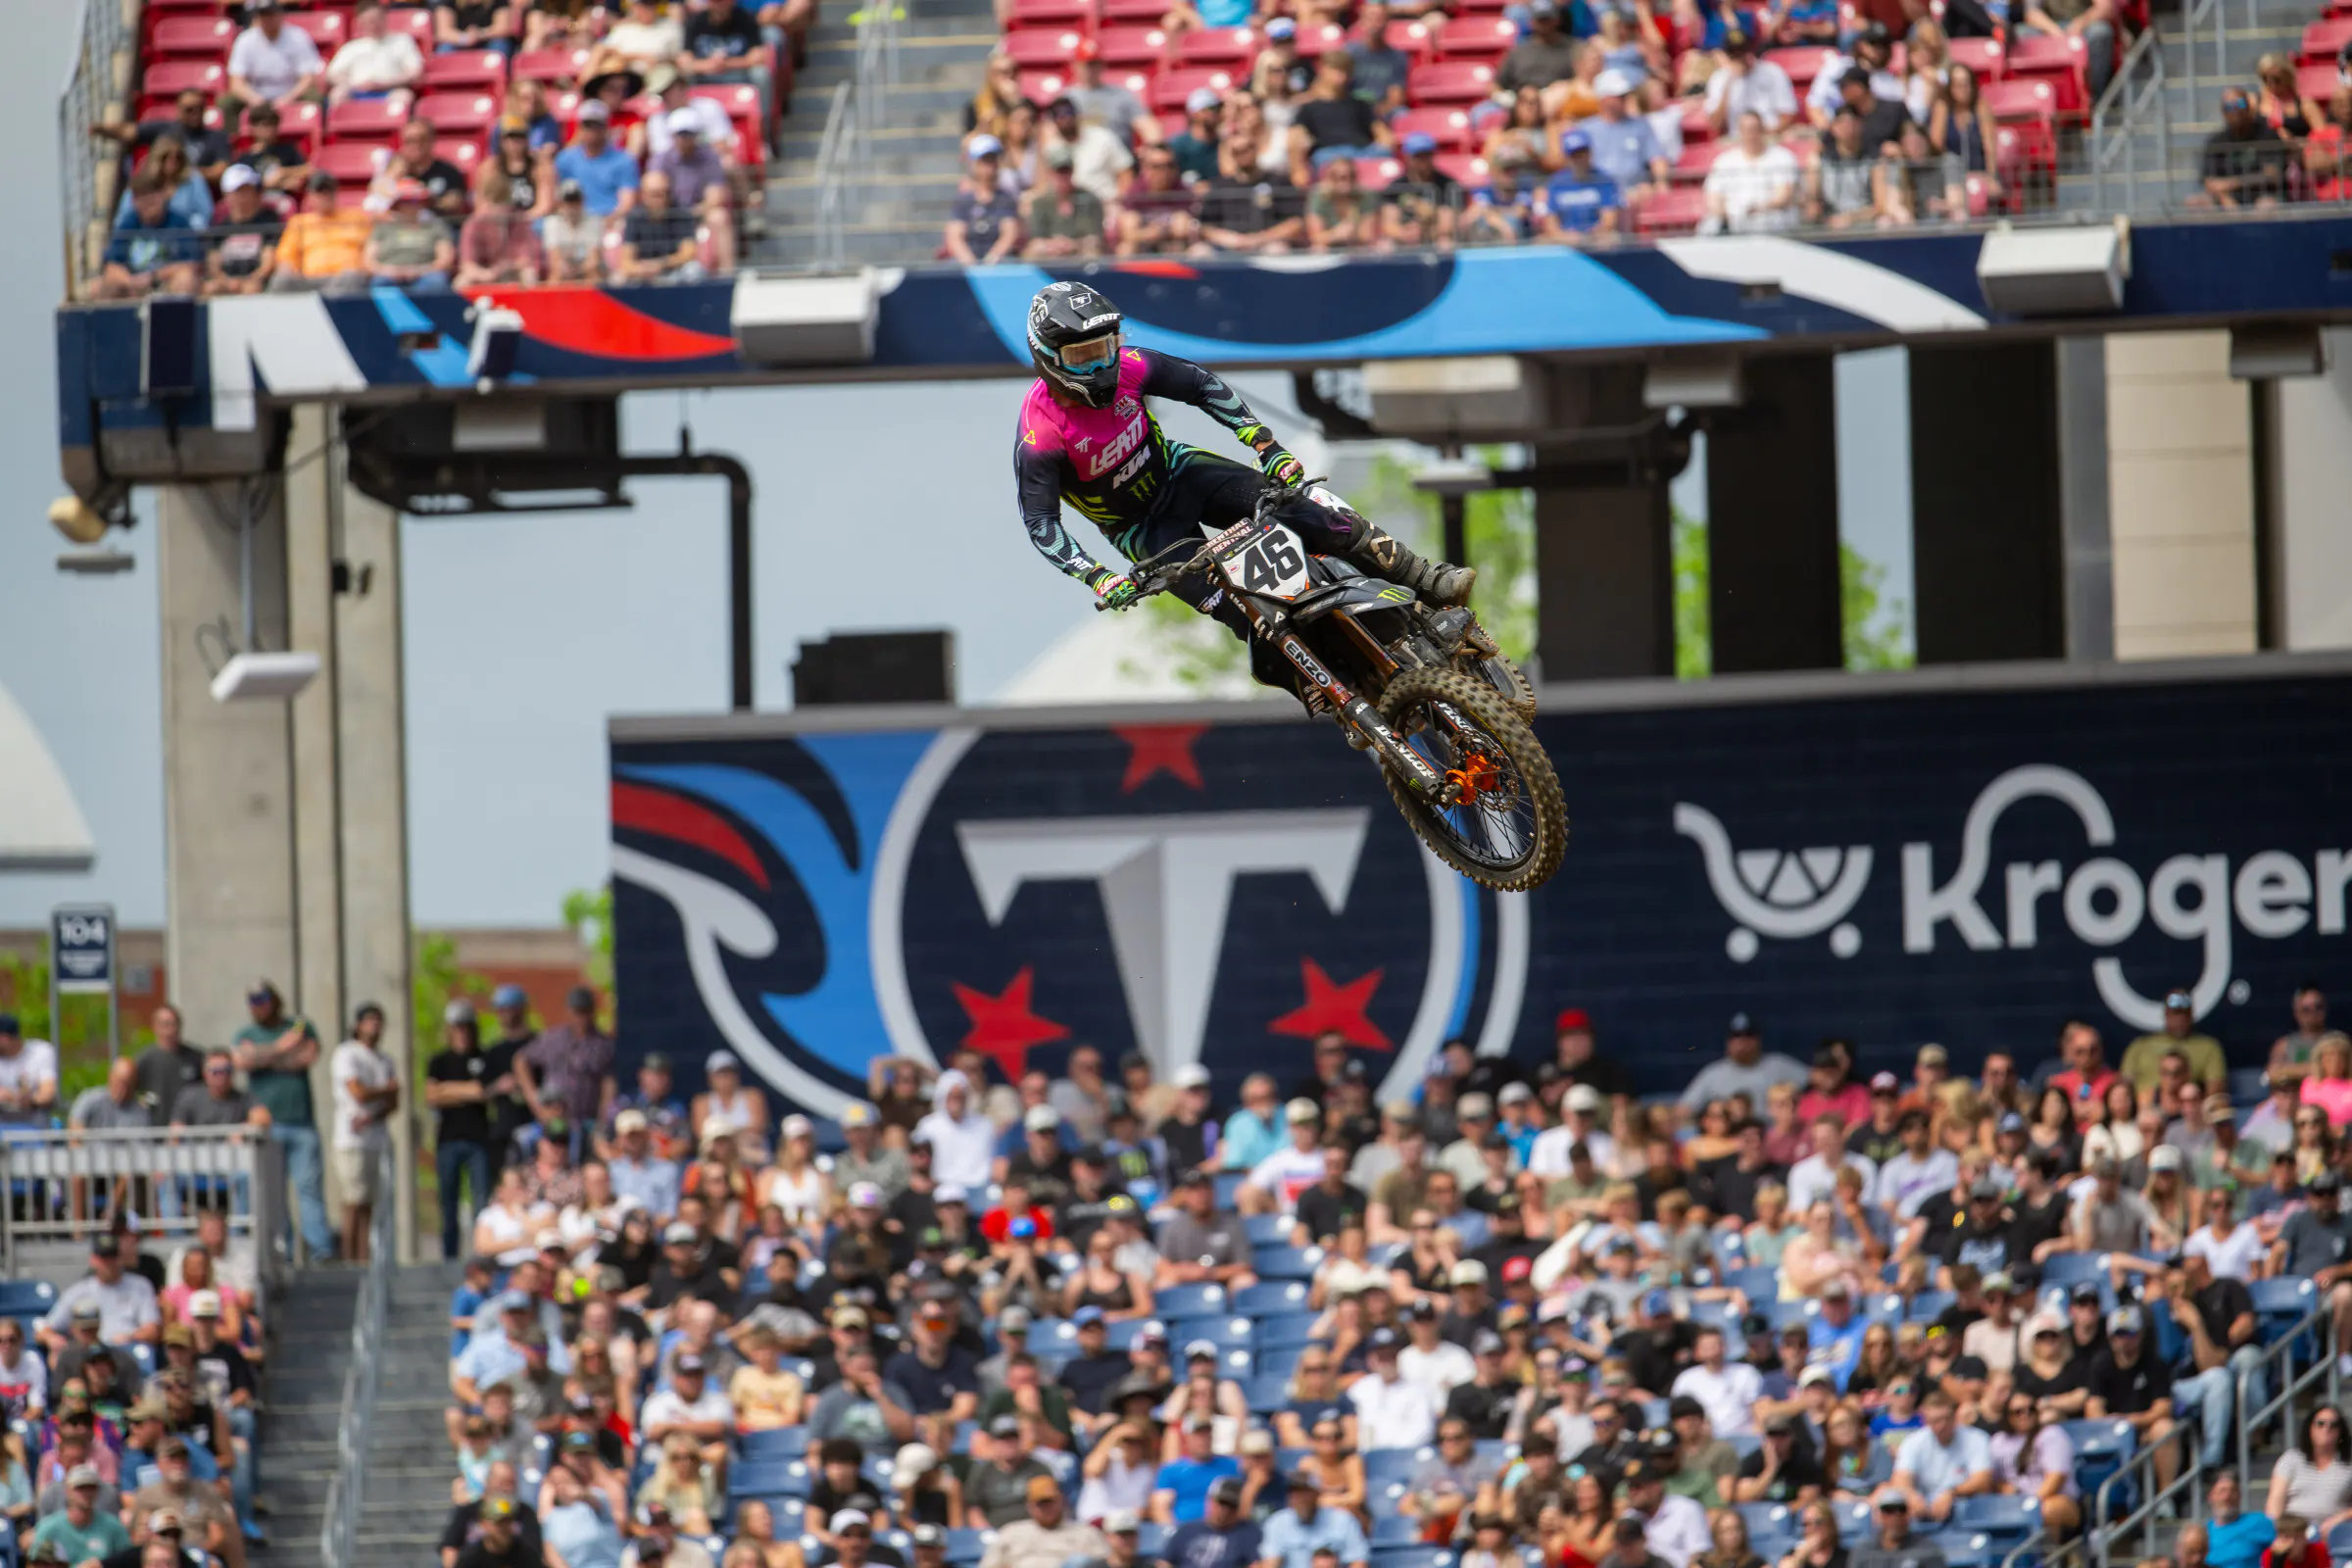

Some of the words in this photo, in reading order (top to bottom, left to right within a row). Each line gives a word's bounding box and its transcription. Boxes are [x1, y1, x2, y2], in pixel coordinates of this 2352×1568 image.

[1083, 313, 1120, 330] LEATT
[1090, 410, 1143, 476] LEATT
[1112, 444, 1152, 490] KTM
[1205, 519, 1249, 549] RENTHAL
[1244, 529, 1304, 593] 46
[1284, 640, 1331, 687] ENZO
[1374, 725, 1437, 779] DUNLOP
[1899, 764, 2352, 1029] Kroger
[60, 916, 106, 947] 104
